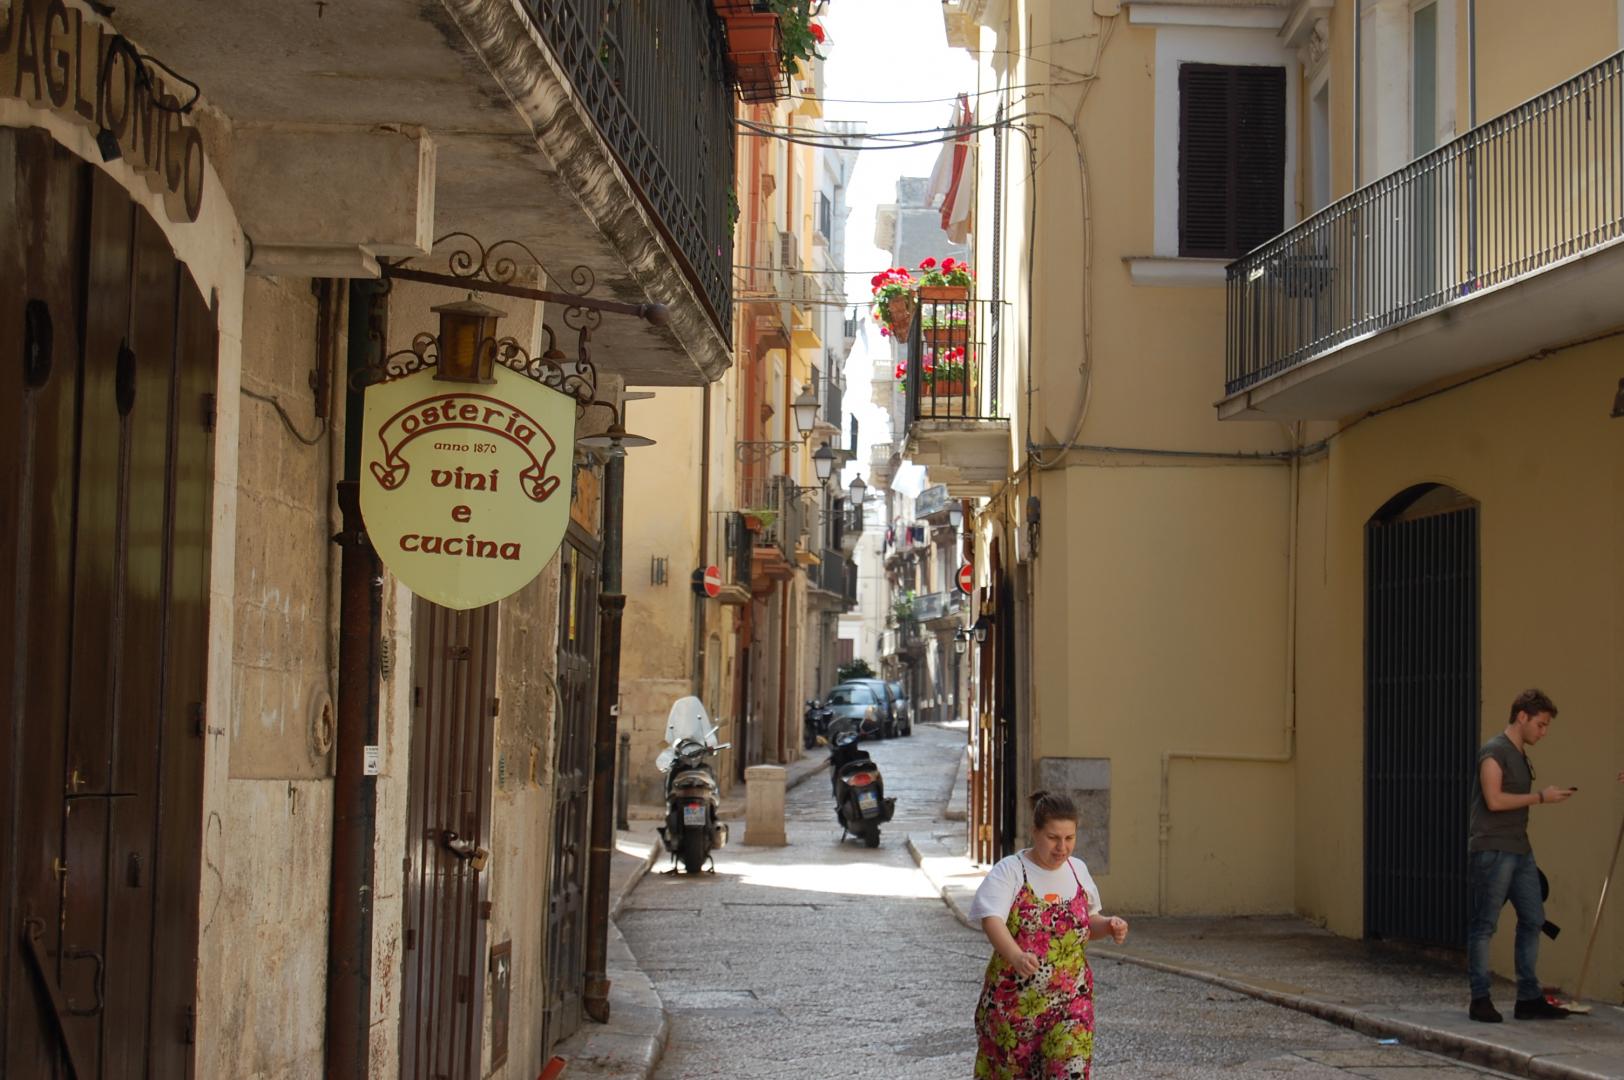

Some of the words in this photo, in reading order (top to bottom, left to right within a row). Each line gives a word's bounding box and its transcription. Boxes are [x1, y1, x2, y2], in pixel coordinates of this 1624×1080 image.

[401, 399, 537, 446] osteria
[434, 441, 469, 453] anno
[473, 442, 497, 454] 1870
[430, 466, 499, 492] vini
[451, 505, 472, 523] e
[399, 533, 522, 561] cucina
